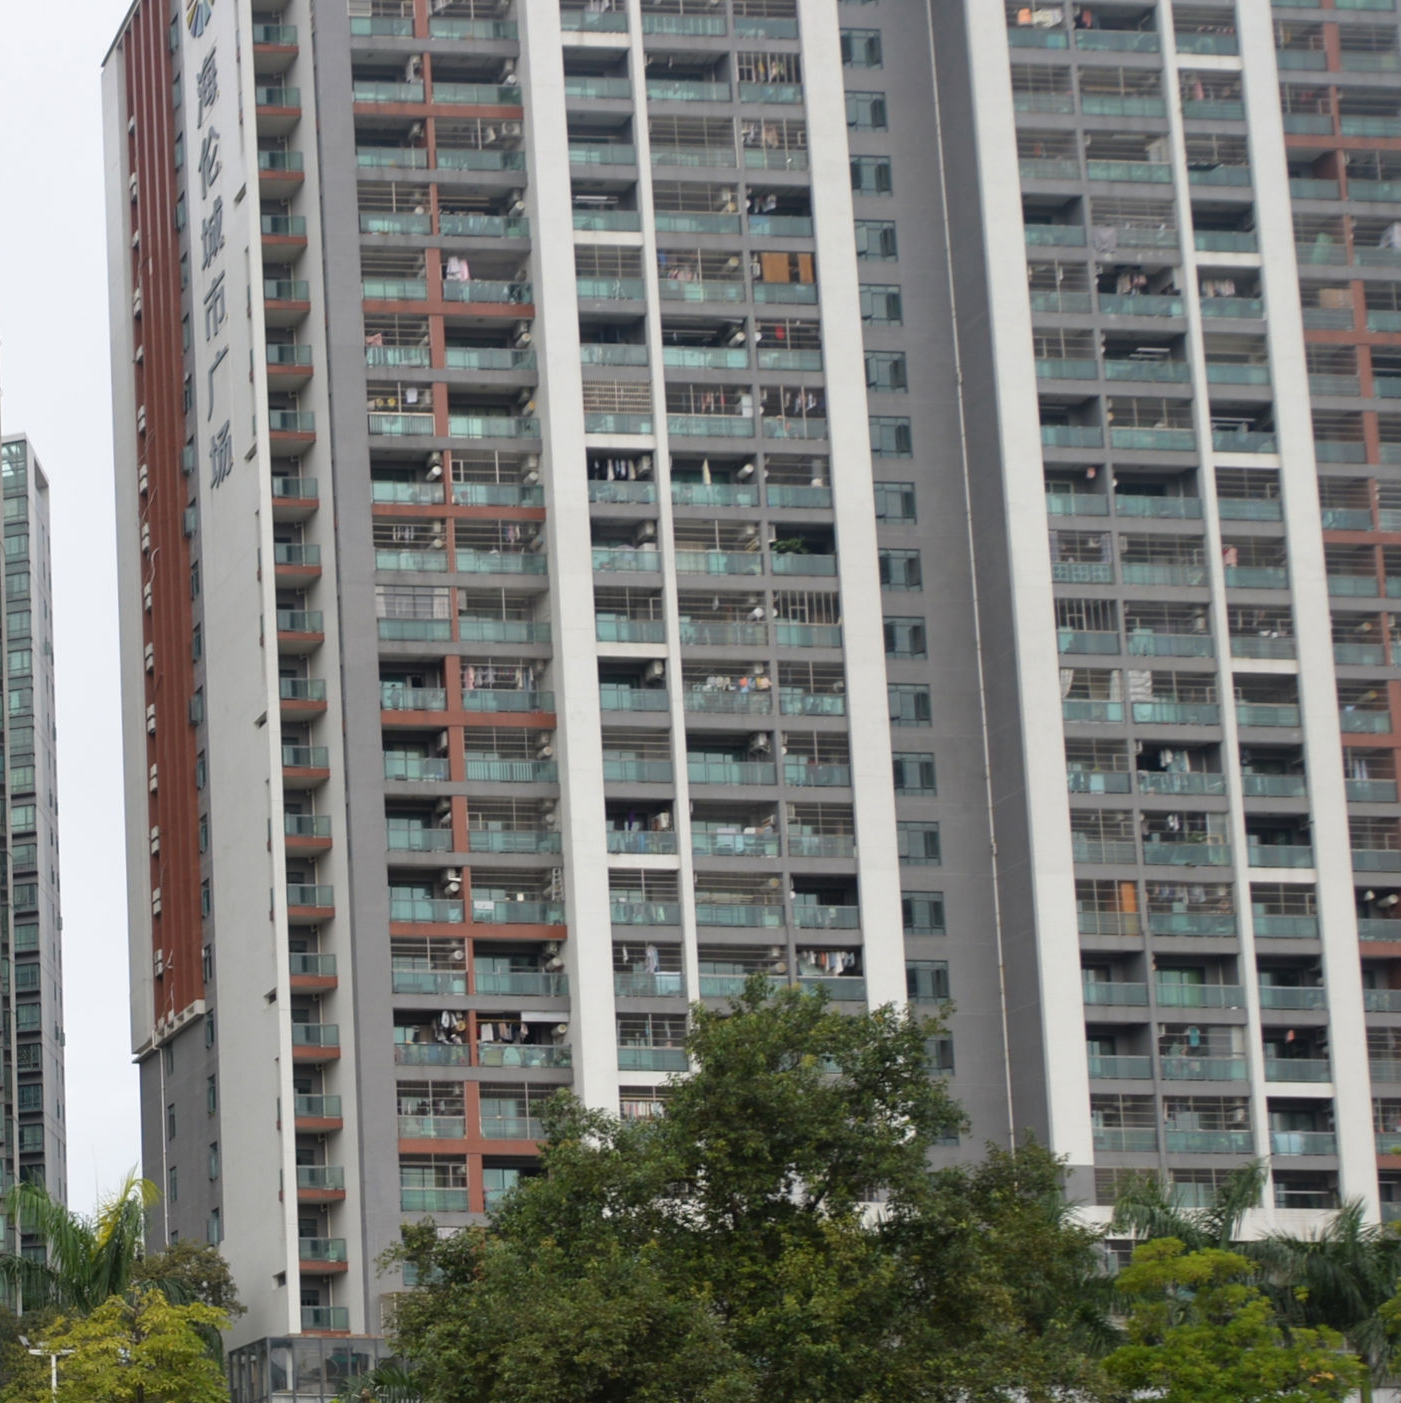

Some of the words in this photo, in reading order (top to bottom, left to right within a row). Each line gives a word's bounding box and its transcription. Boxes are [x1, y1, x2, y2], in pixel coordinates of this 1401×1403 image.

[196, 45, 233, 490] 海伦城市广场
